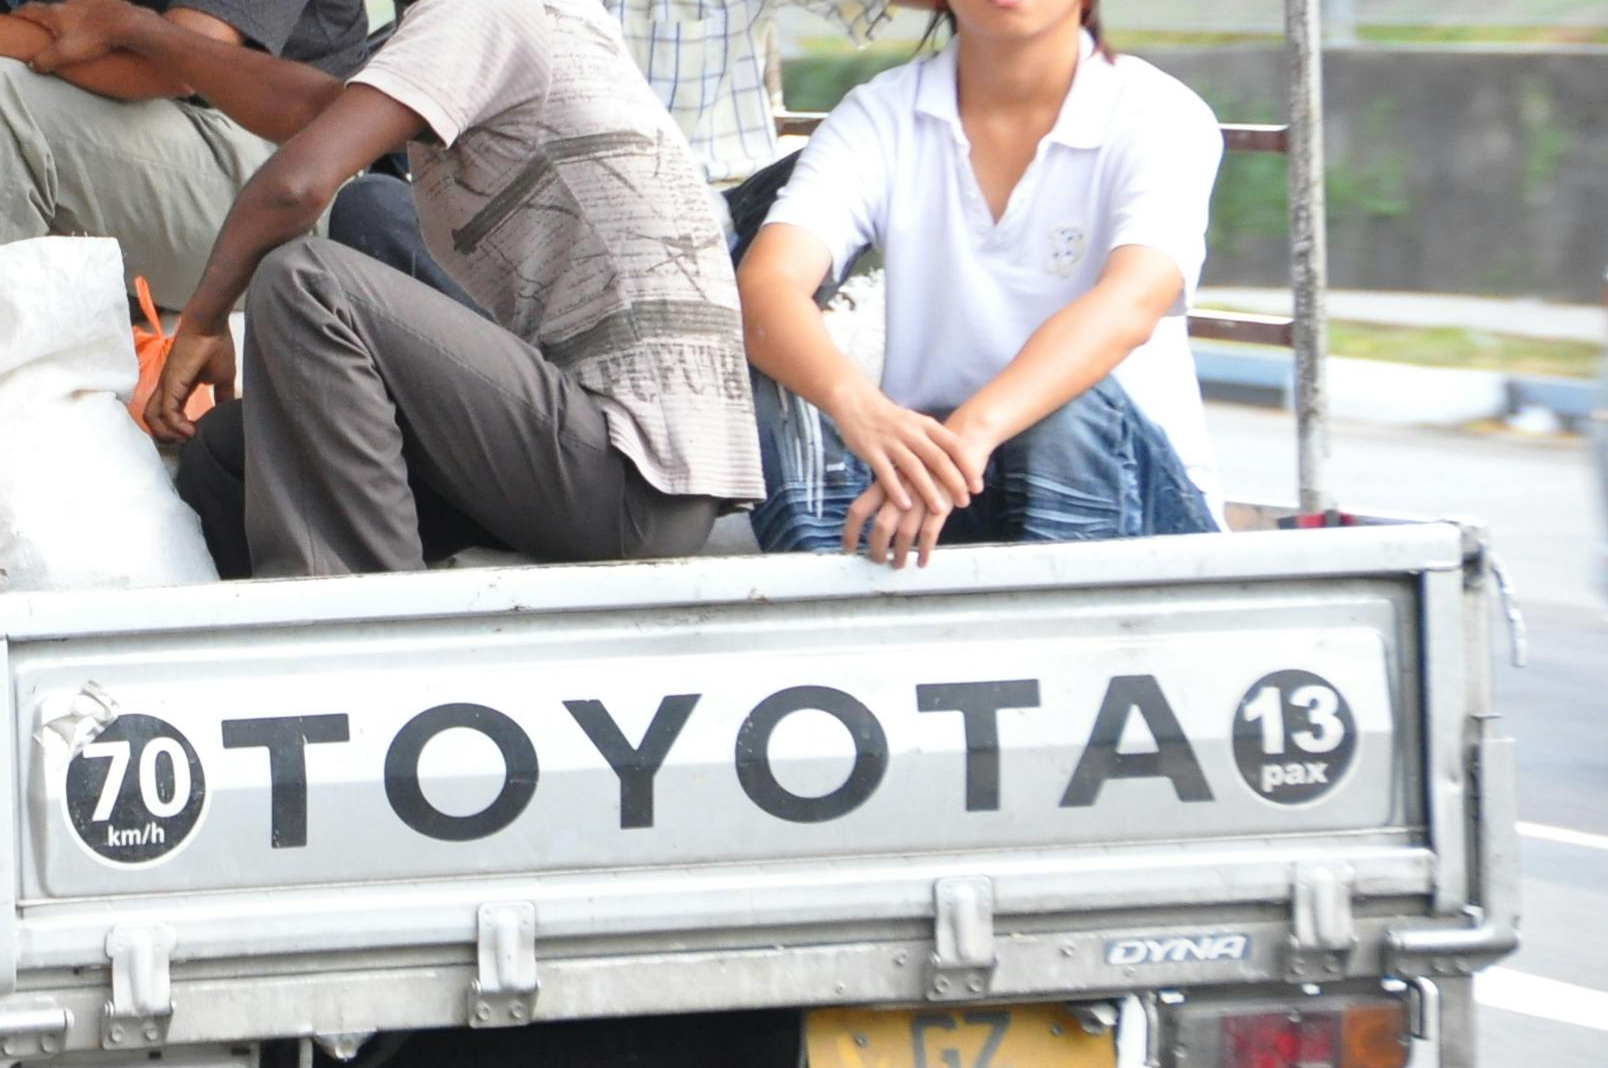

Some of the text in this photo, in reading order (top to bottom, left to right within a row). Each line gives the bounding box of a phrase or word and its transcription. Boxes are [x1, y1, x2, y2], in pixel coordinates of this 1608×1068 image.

[1243, 684, 1344, 754] 13
[82, 736, 192, 822] 70
[221, 677, 1214, 849] TOYOTA
[1260, 762, 1329, 793] pax
[107, 822, 165, 847] km/h
[1108, 935, 1248, 965] DYNA
